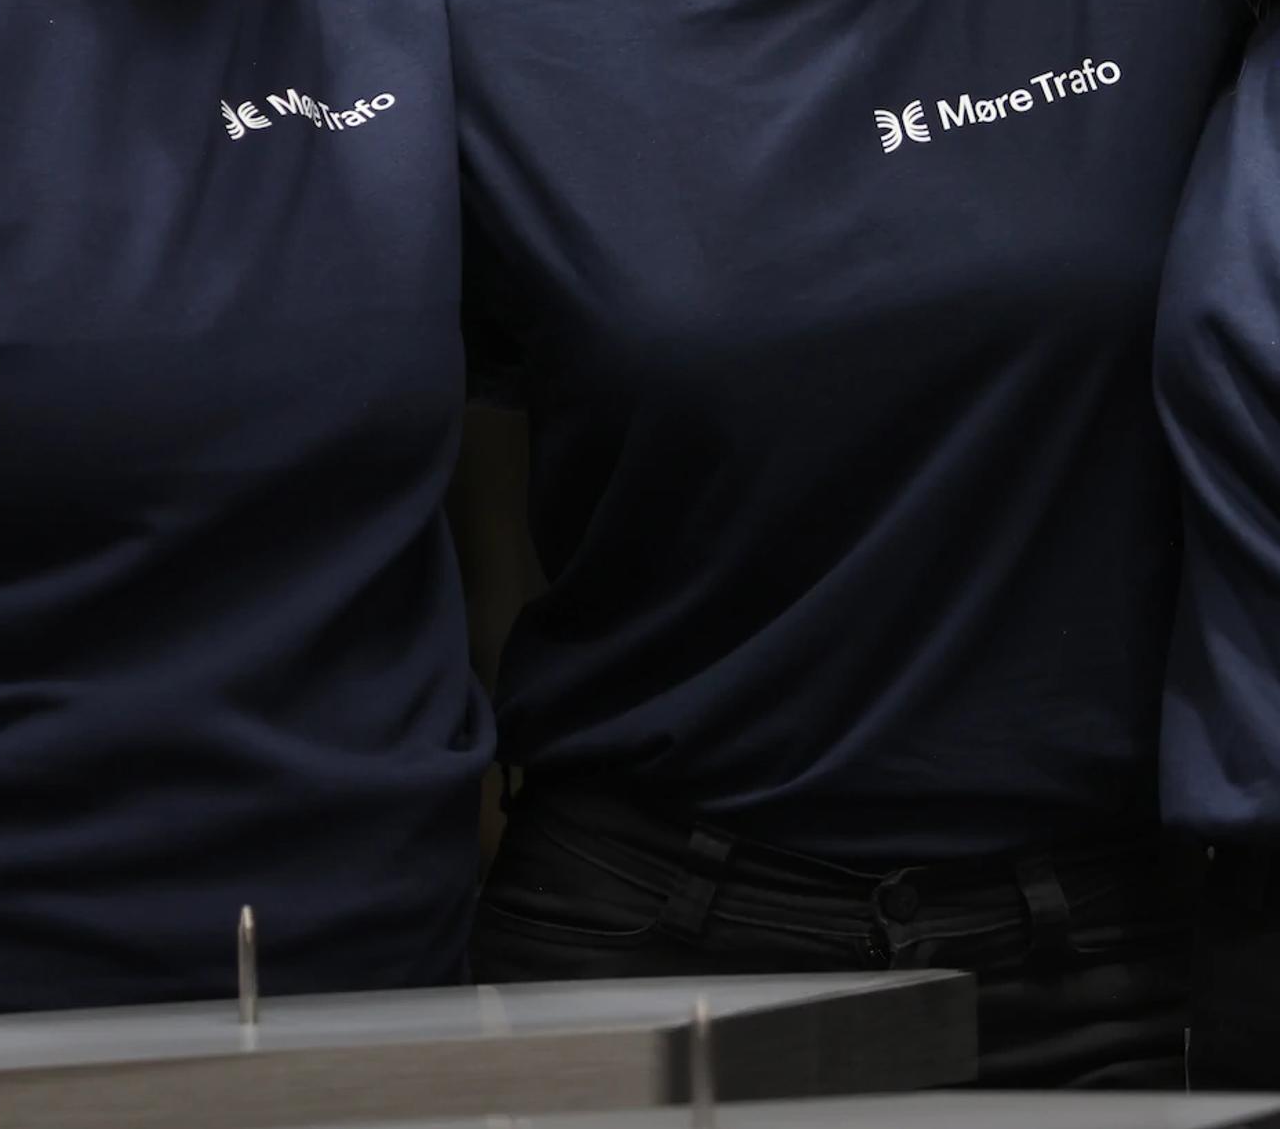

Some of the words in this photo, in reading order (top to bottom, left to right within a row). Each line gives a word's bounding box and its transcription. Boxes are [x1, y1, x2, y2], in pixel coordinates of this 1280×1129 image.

[318, 93, 396, 130] Trafo
[936, 89, 1034, 130] Møre
[1029, 58, 1121, 103] Trafo
